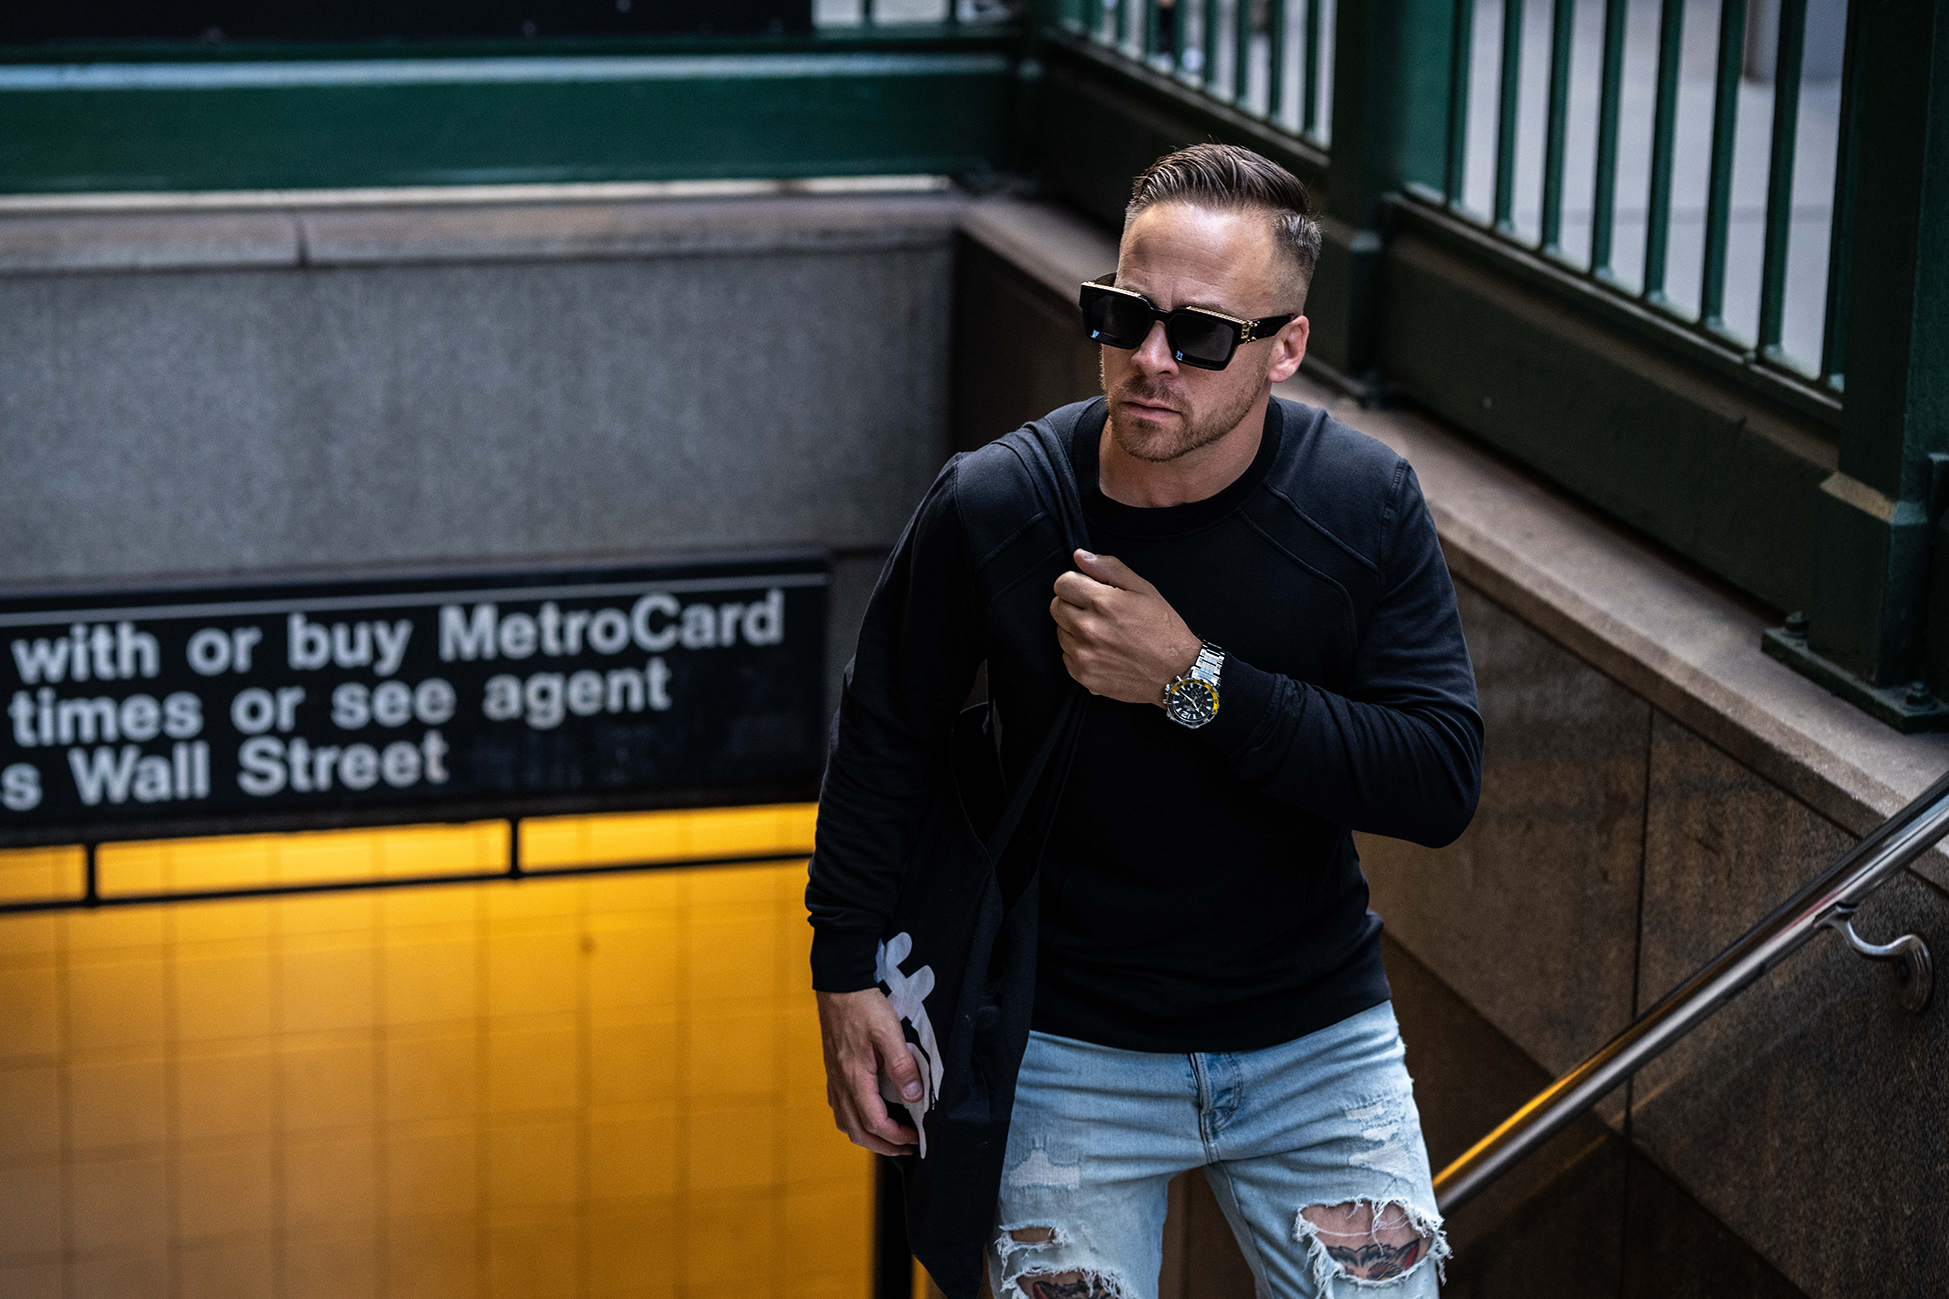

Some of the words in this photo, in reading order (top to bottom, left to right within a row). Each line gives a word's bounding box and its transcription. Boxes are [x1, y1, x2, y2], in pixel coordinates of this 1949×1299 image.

[11, 620, 160, 684] with
[186, 627, 262, 676] or
[287, 612, 413, 675] buy
[439, 588, 784, 662] MetroCard
[8, 687, 205, 747] times
[230, 686, 306, 734] or
[332, 678, 456, 729] see
[483, 657, 671, 729] agent
[1, 762, 42, 811] s
[67, 740, 212, 805] Wall
[237, 731, 448, 796] Street
